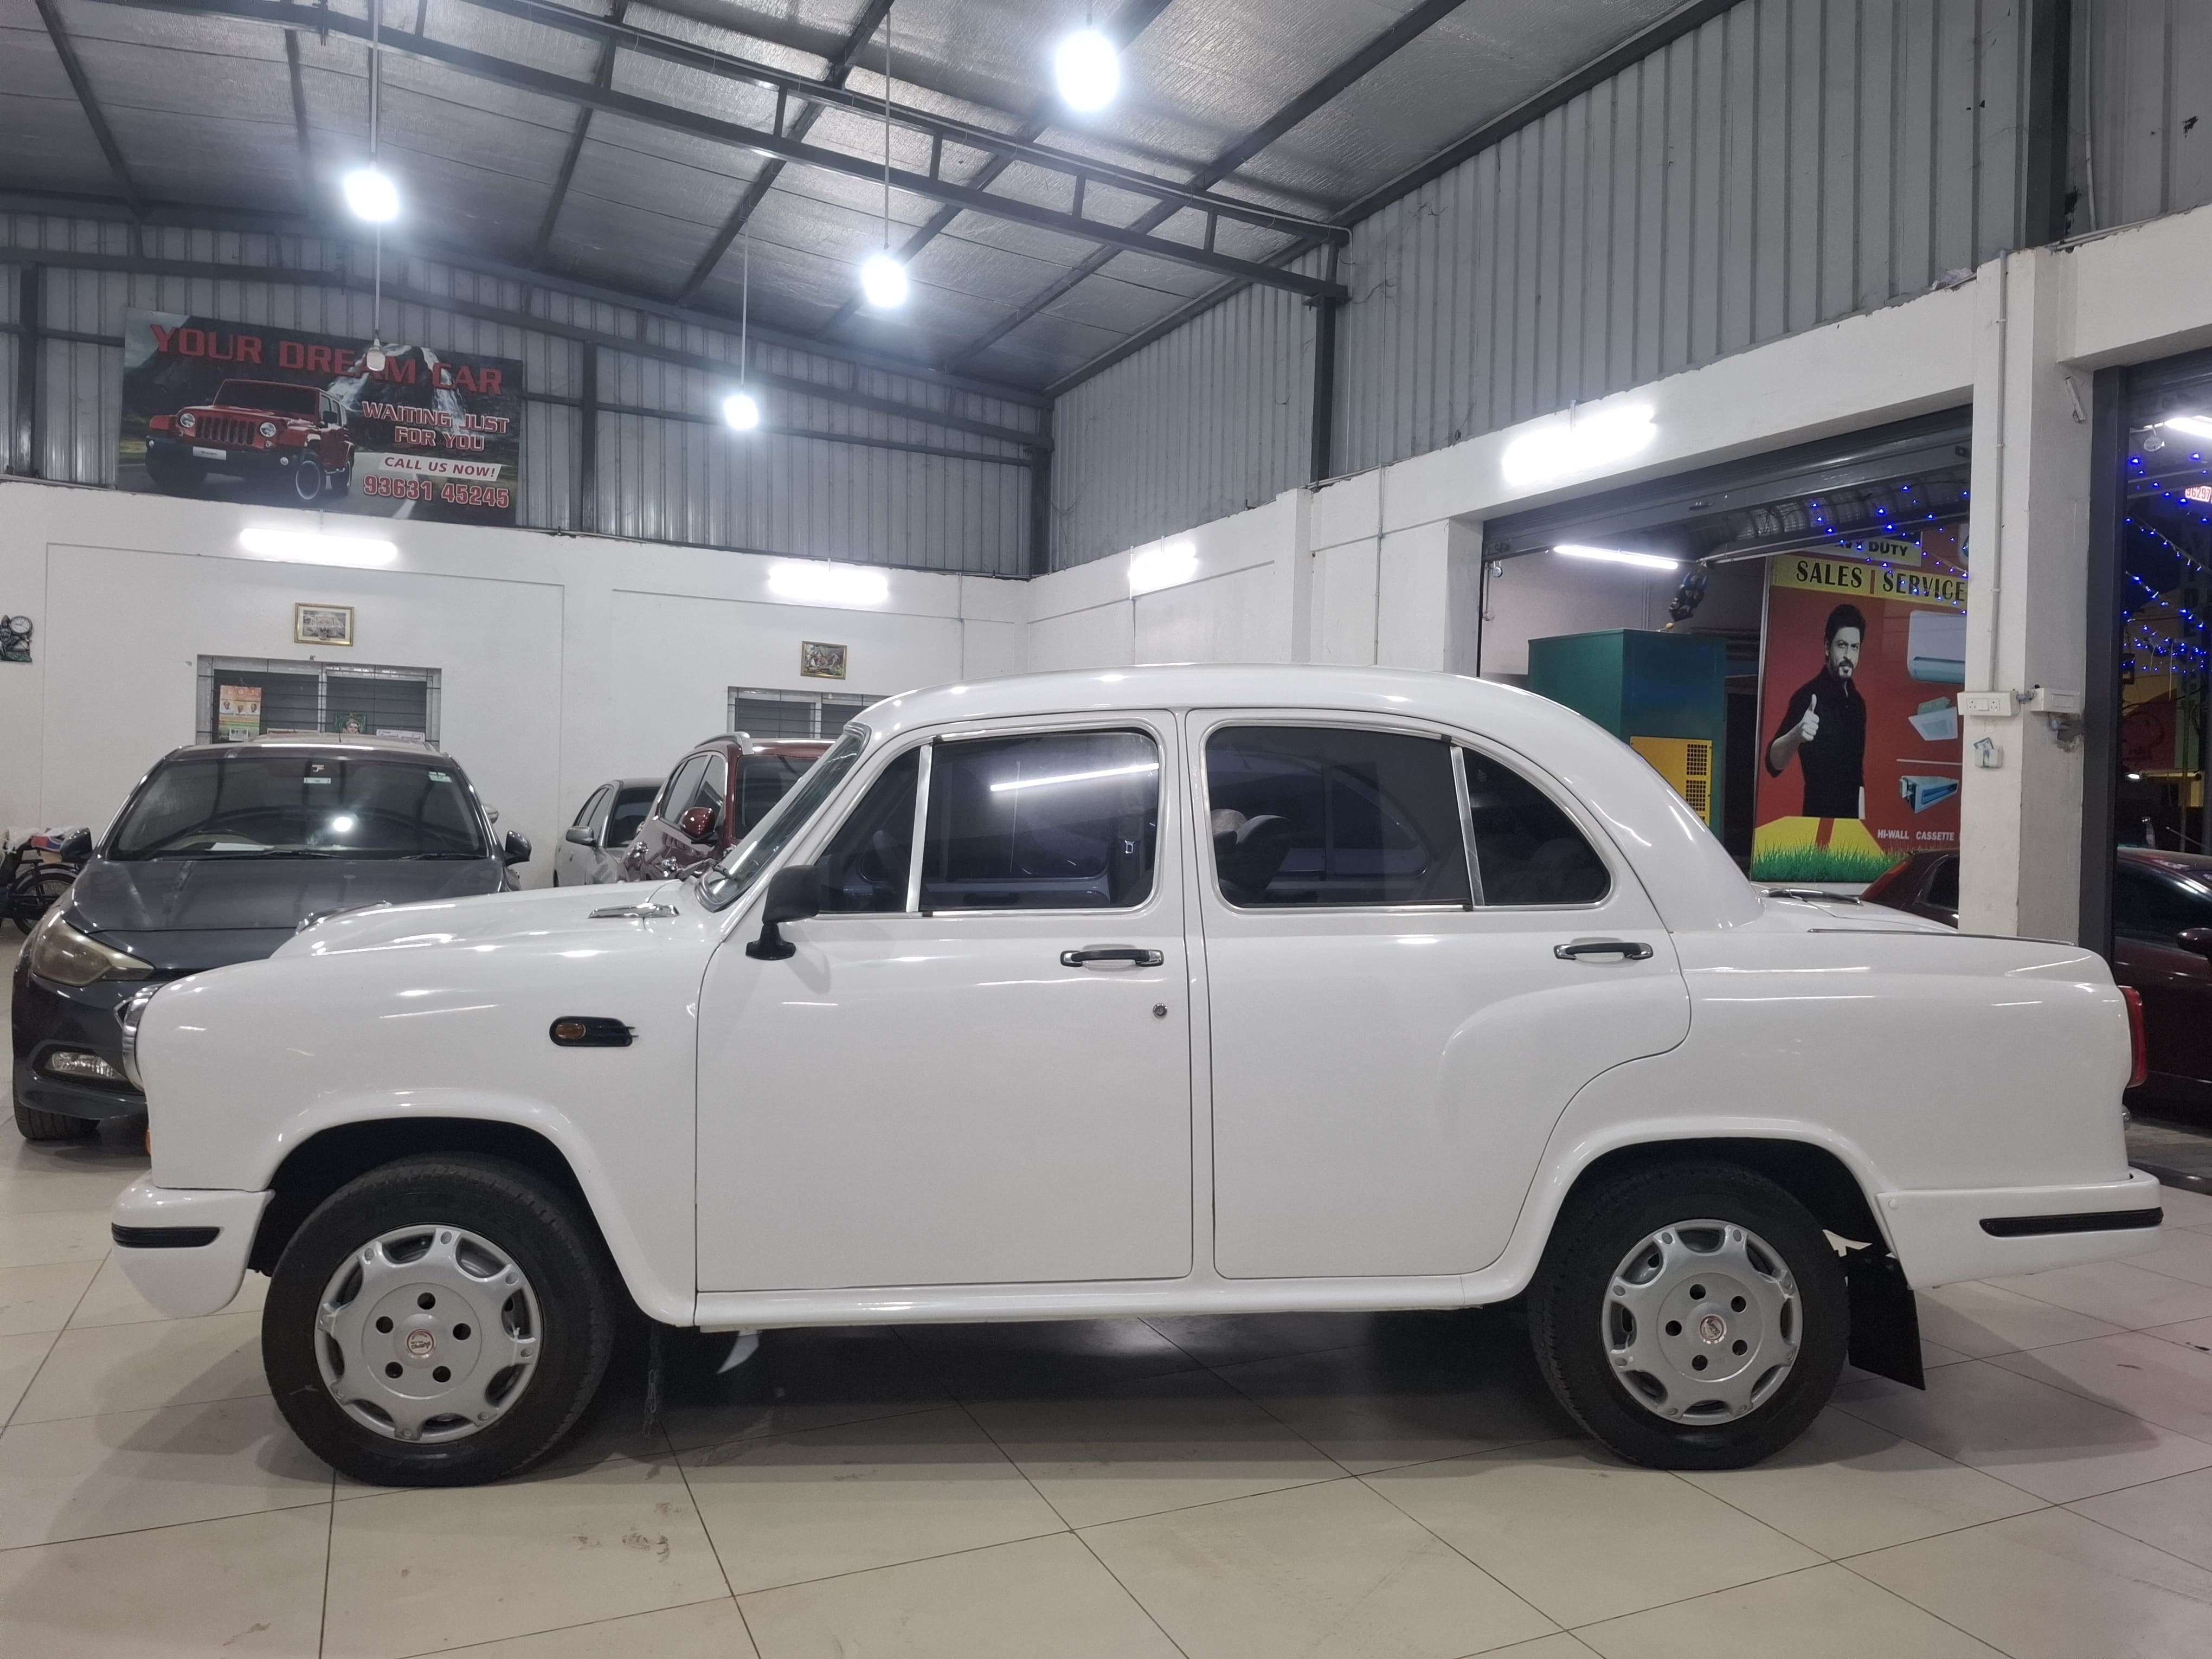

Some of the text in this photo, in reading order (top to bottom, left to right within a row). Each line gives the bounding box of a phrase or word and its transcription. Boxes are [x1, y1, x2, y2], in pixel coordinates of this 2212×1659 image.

[150, 324, 261, 364] YOUR
[432, 363, 502, 395] CAR
[362, 401, 509, 434] WAITING JUST
[395, 426, 484, 452] FOR YOU
[384, 457, 495, 477] CALL US NOW!
[364, 475, 509, 508] 93631 45245
[1868, 542, 1908, 556] DUTY
[1797, 561, 1965, 601] SALES SERVICE
[1877, 829, 1954, 840] HI-WALL CASSETTE
